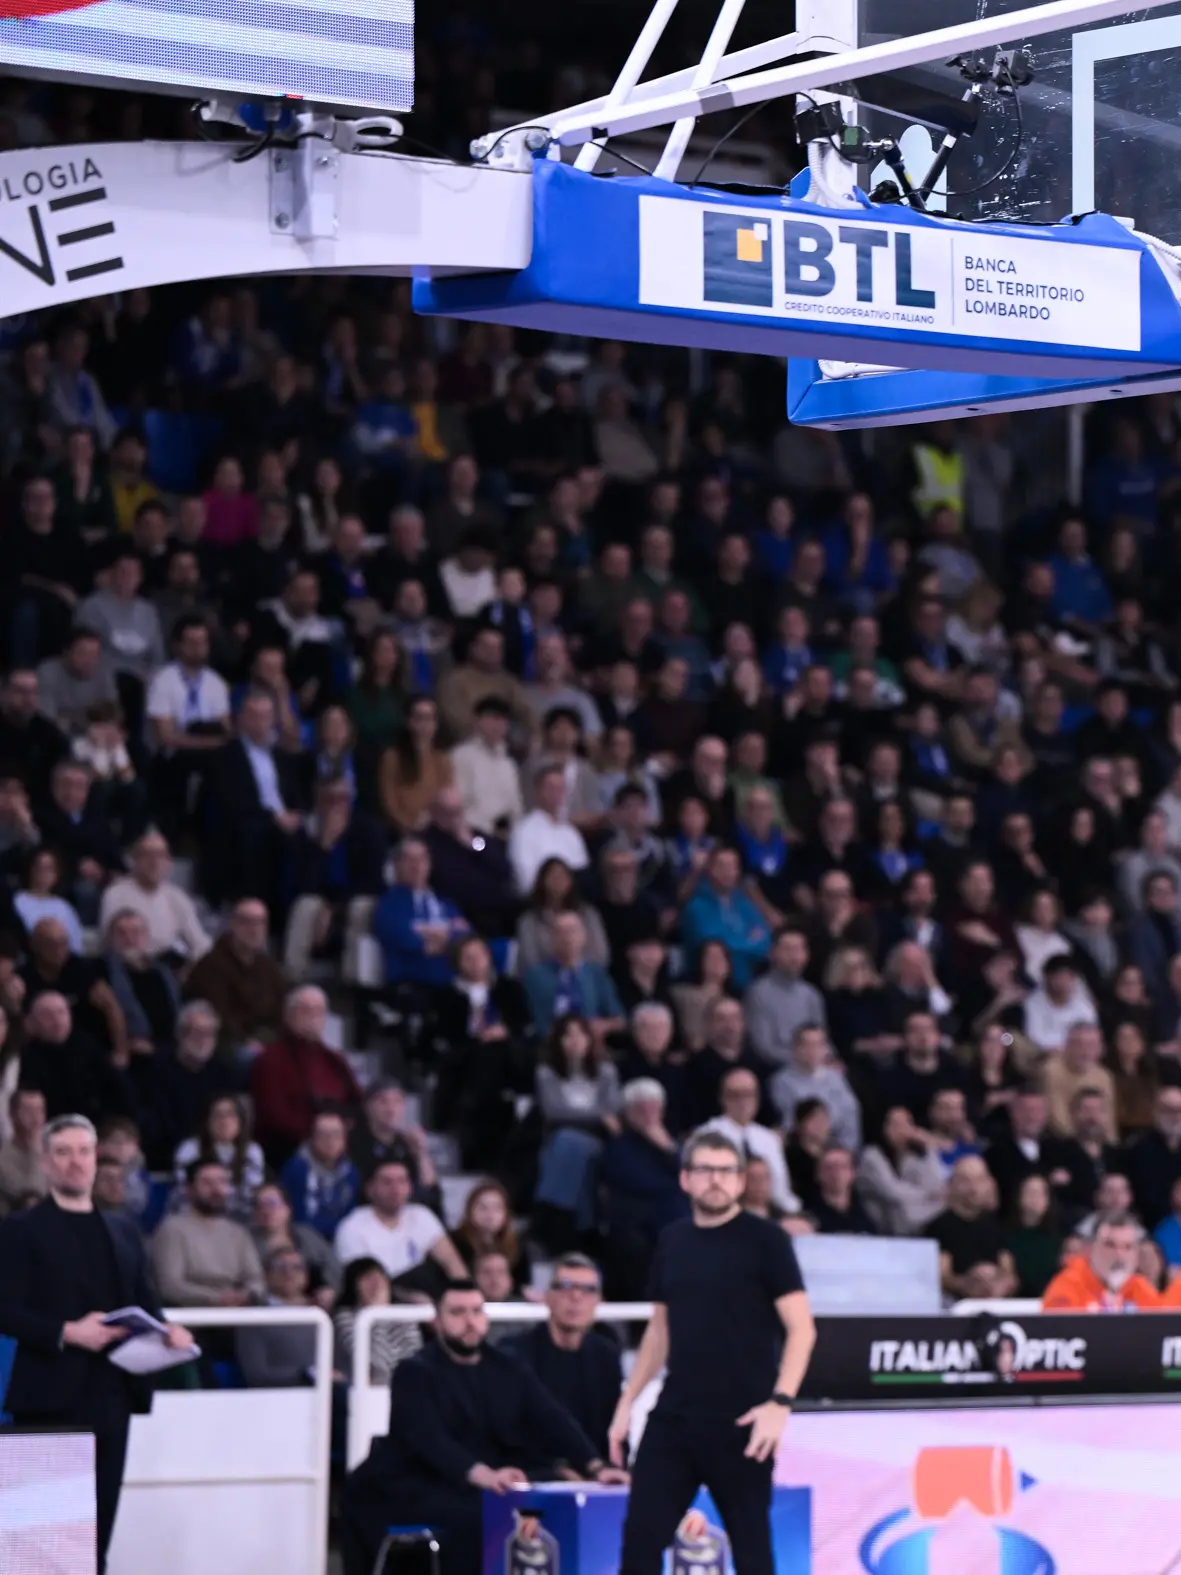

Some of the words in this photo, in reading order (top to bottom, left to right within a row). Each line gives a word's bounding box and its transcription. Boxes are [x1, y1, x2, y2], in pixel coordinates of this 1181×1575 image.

[0, 157, 102, 200] LOGIA
[783, 219, 936, 309] BTL
[965, 256, 1017, 274] BANCA
[965, 277, 993, 293] DEL
[997, 280, 1085, 302] TERRITORIO
[785, 301, 824, 314] CREDITO
[826, 305, 891, 320] COOPERATIVO
[892, 312, 935, 324] ITALIANO
[965, 299, 1050, 320] LOMBARDO
